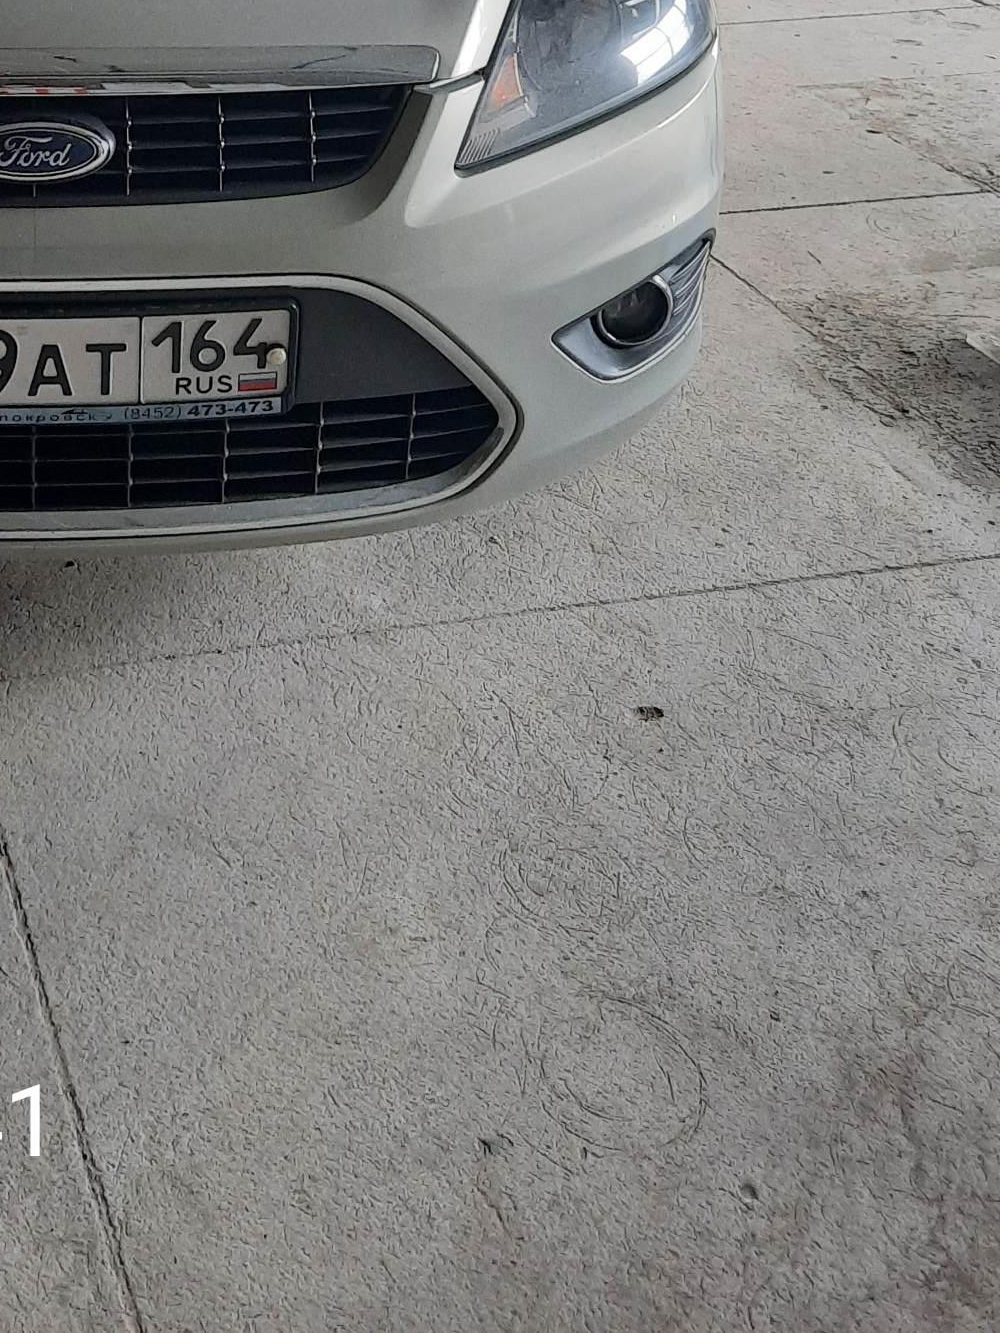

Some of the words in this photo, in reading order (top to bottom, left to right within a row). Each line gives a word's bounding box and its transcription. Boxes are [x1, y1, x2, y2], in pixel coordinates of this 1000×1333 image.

[151, 318, 267, 373] 164
[175, 375, 233, 395] RUS
[124, 405, 182, 421] (8452)
[187, 400, 274, 417] 473-473
